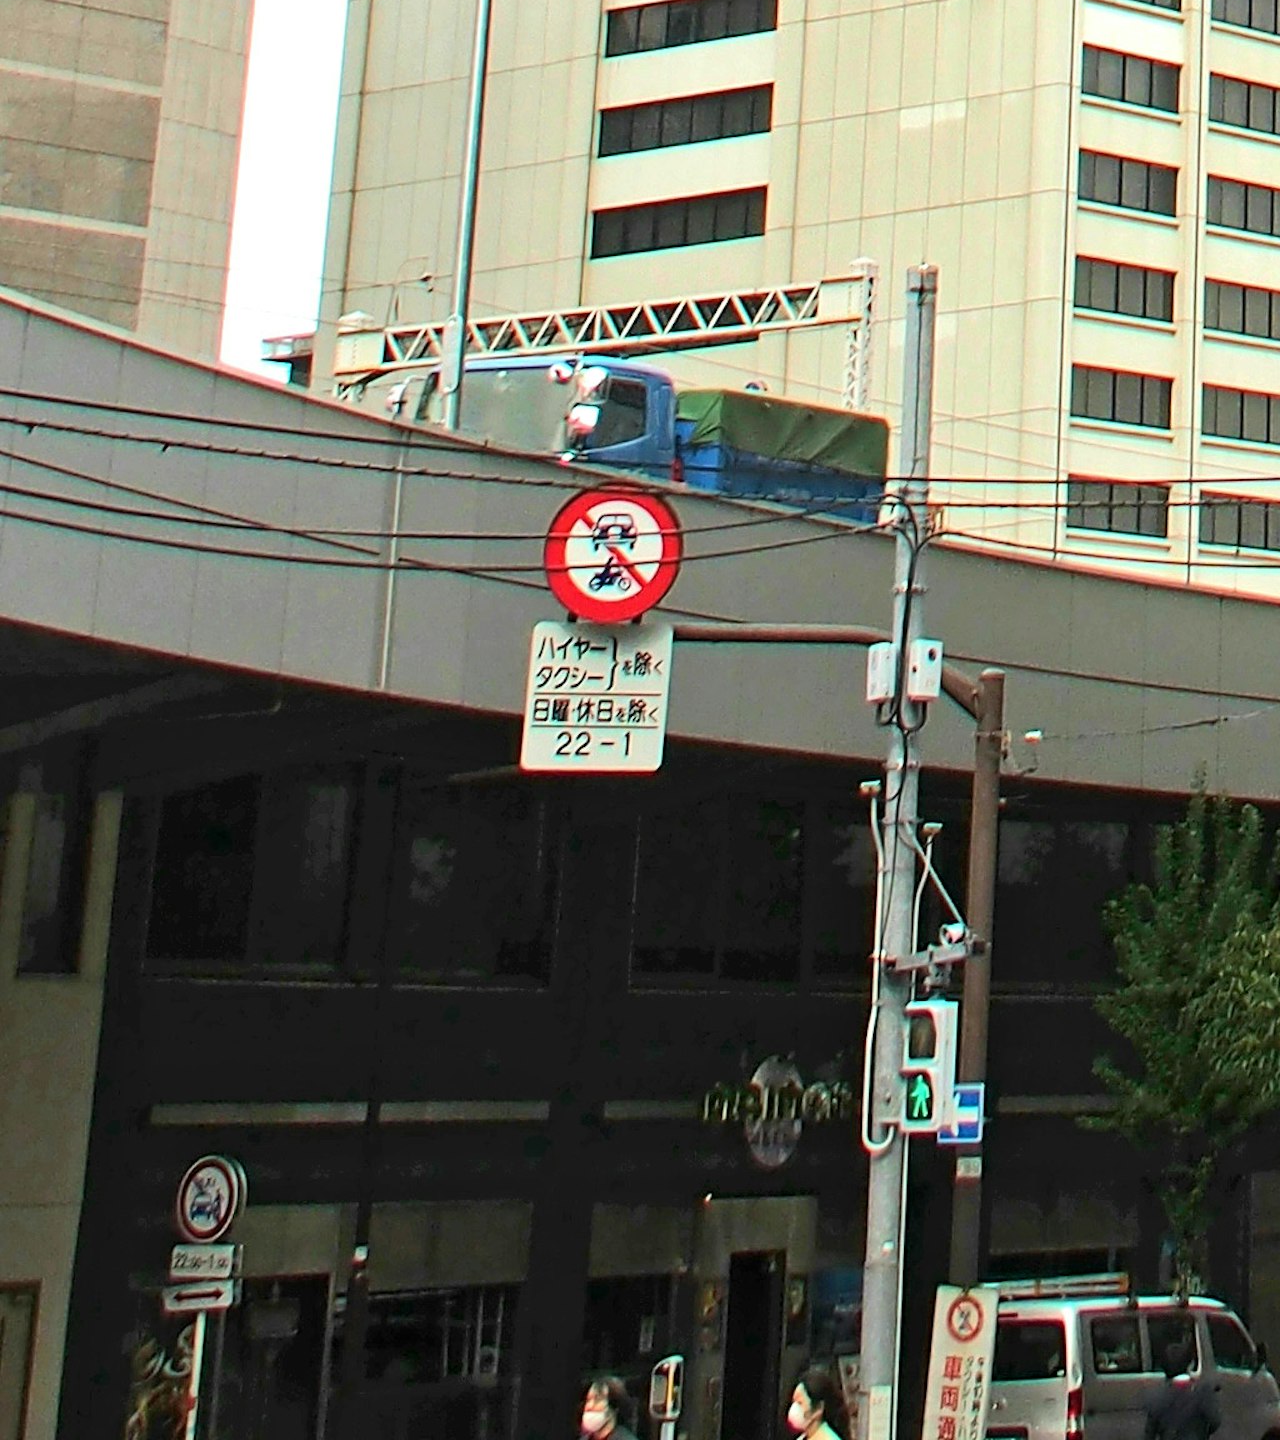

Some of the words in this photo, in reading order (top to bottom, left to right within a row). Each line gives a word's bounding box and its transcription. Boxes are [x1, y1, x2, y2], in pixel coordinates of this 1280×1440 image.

[538, 636, 607, 661] ハイヤー
[622, 651, 664, 677] を除く
[536, 666, 604, 689] タクシー
